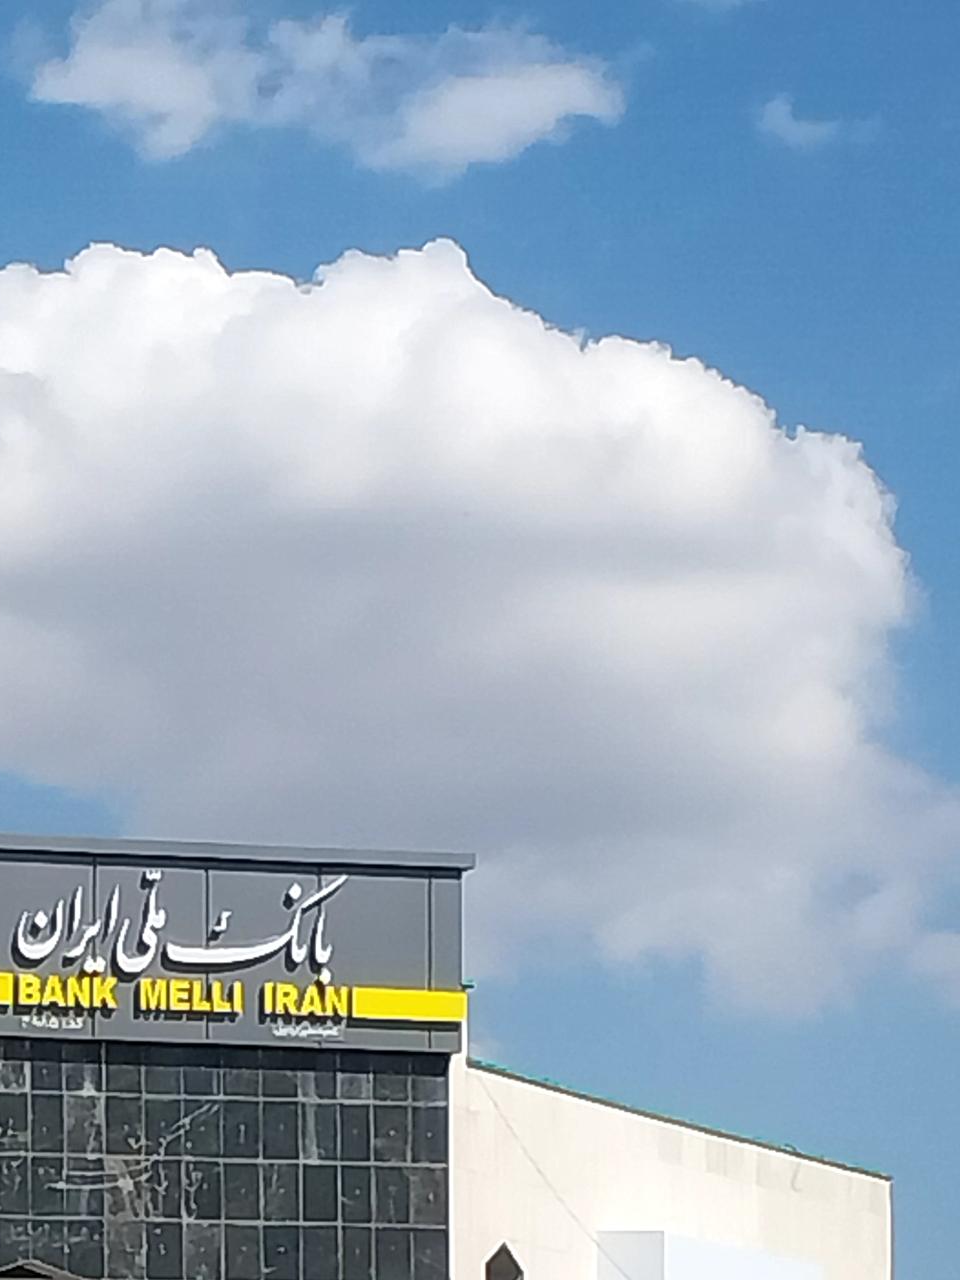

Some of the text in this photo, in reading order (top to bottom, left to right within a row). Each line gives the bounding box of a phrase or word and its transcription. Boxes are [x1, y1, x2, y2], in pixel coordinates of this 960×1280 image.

[17, 884, 119, 974] ایران
[165, 873, 349, 983] بانک
[18, 973, 349, 1018] BANK MELLI IRAN
